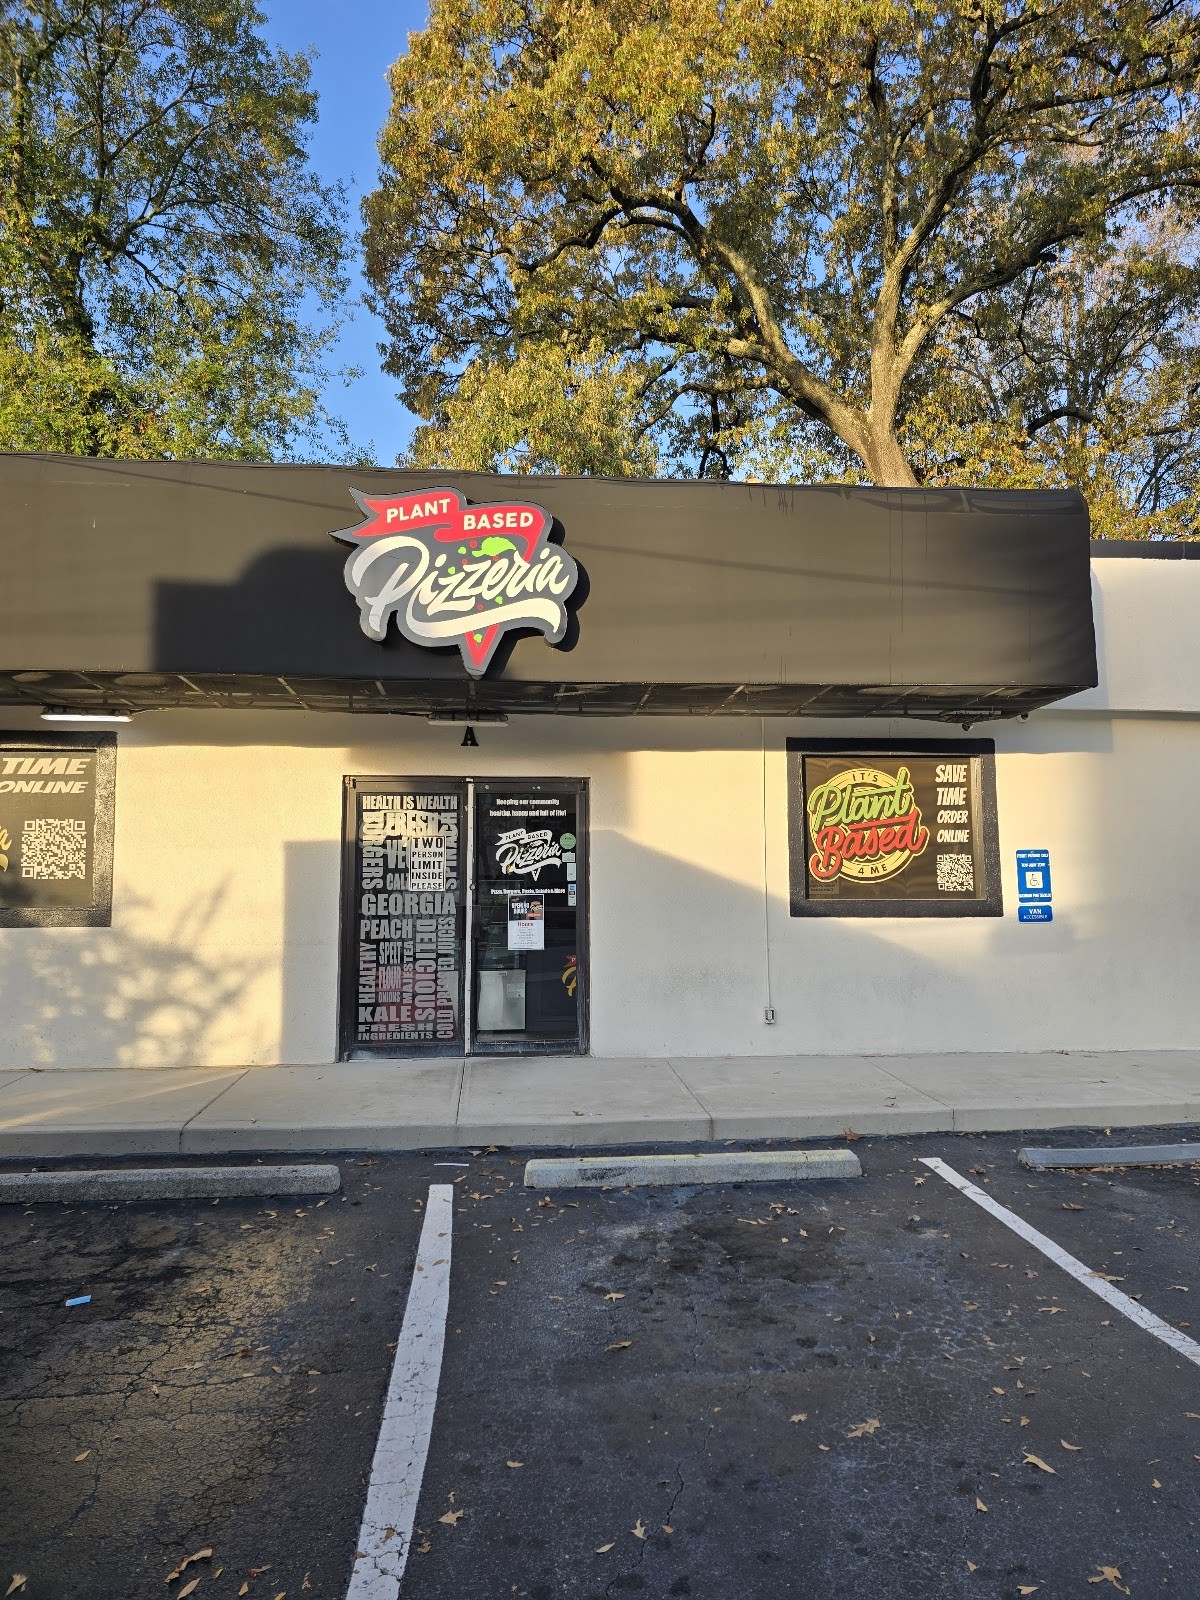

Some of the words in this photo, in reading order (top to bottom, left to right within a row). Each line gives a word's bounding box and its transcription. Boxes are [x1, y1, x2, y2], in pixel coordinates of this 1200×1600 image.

[386, 498, 451, 524] PLANT
[463, 512, 534, 531] BASED
[351, 535, 570, 638] Pizzeria
[461, 726, 479, 746] A
[2, 757, 91, 775] TIME
[935, 764, 968, 783] SAVE
[852, 772, 879, 782] IT'S
[0, 780, 89, 794] ONLINE
[936, 787, 967, 806] TIME
[362, 795, 401, 810] HEALTH
[403, 795, 415, 810] IS
[416, 795, 458, 810] WEALTH
[810, 767, 911, 831] Plant
[936, 810, 968, 824] ORDER
[412, 837, 444, 849] TWO
[505, 830, 524, 841] PLANT
[811, 808, 928, 878] Based
[936, 829, 970, 843] ONLINE
[361, 811, 384, 890] BURGERS
[495, 841, 563, 875] Pizzeria
[411, 860, 443, 869] LIMIT
[857, 867, 865, 875] 4
[870, 863, 888, 874] ME
[411, 871, 443, 880] INSIDE
[411, 882, 443, 890] PLEASE
[361, 892, 457, 915] GEORGIA
[360, 918, 414, 940] PEACH
[437, 916, 456, 955] JUICES
[379, 941, 402, 965] SPELT
[359, 941, 377, 1004] HEALTHY
[378, 966, 401, 990] FLOUR
[414, 918, 437, 1021] DELICIOUS
[378, 991, 401, 1003] ONIONS
[358, 1005, 412, 1022] KALE
[358, 1022, 434, 1033] FRESH
[436, 1009, 454, 1039] COLD
[357, 1031, 434, 1040] INGREDIENTS
